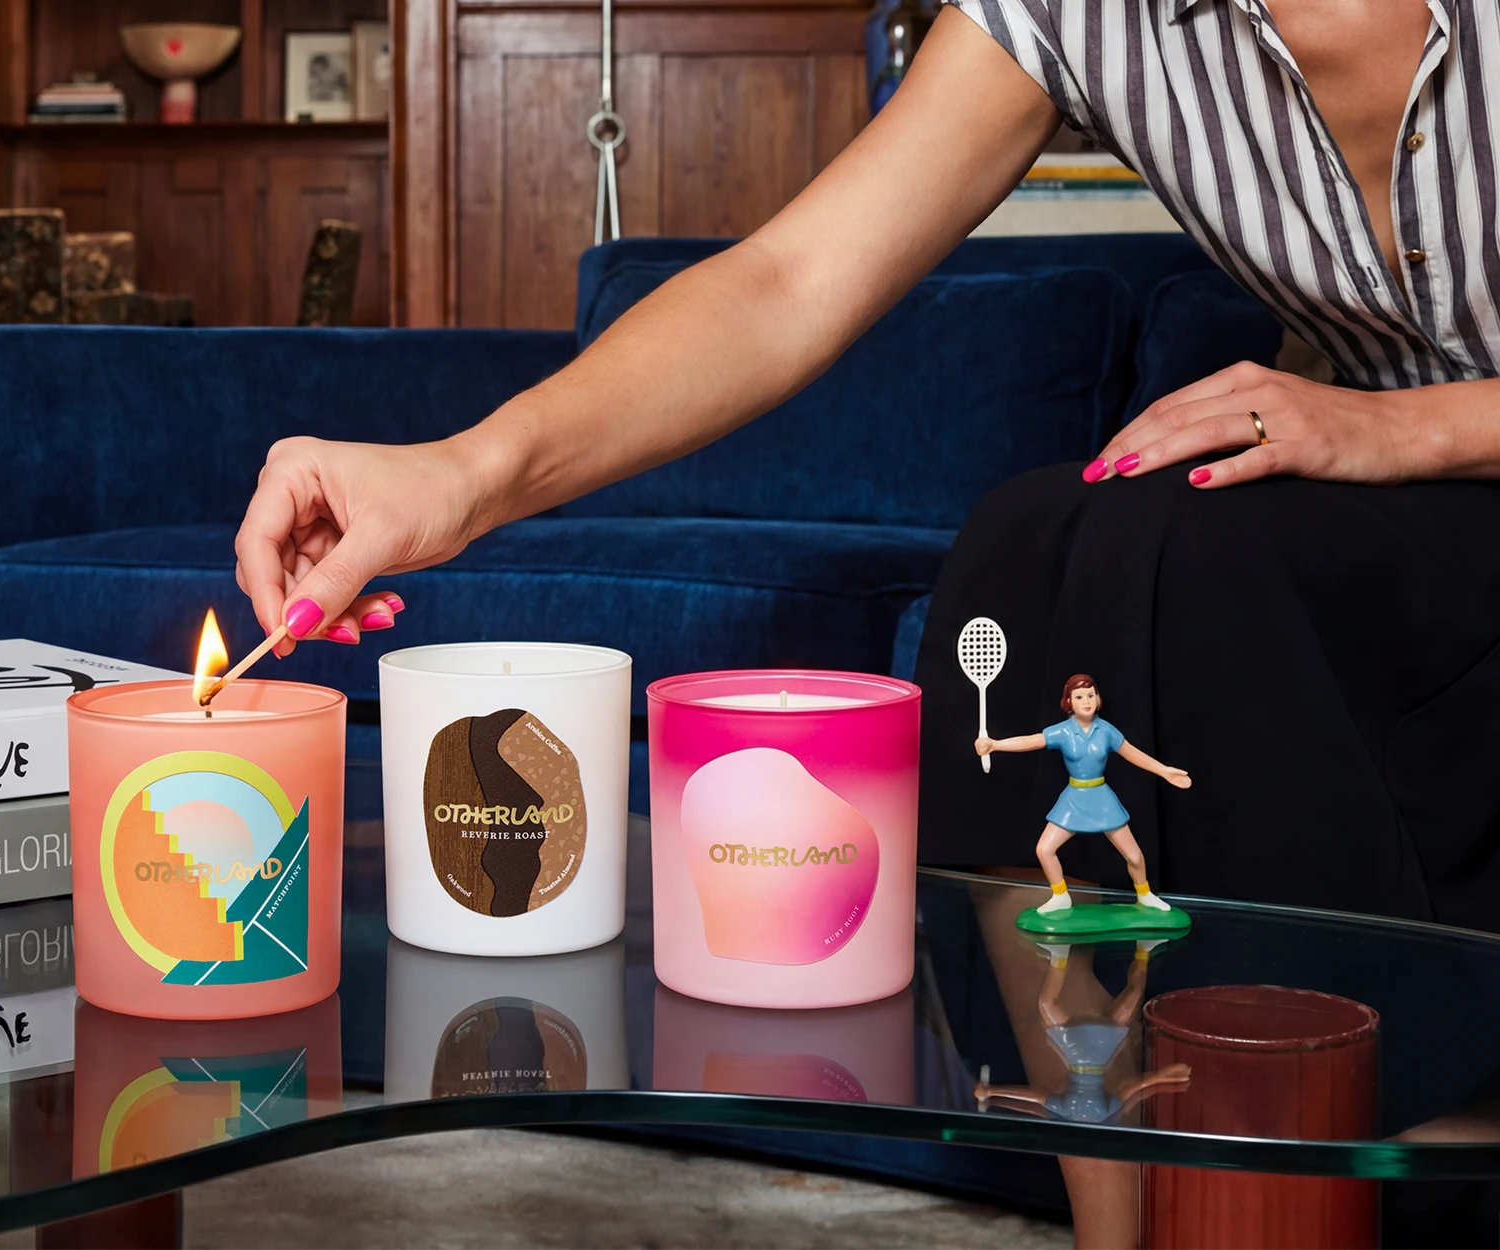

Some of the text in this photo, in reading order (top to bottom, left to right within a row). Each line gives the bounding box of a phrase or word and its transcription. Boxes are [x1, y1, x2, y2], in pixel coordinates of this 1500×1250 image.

[525, 721, 562, 756] Arabica Coffee
[434, 802, 575, 826] OTHERLAND
[461, 830, 551, 841] REVERIE ROAST
[708, 842, 858, 867] OTHERLAND
[134, 856, 283, 885] OTHERLAND
[538, 853, 577, 896] Toasted Almond
[265, 863, 302, 919] MATCHPOINT
[446, 873, 472, 898] Oakwood
[824, 904, 860, 945] RUBY ROOT
